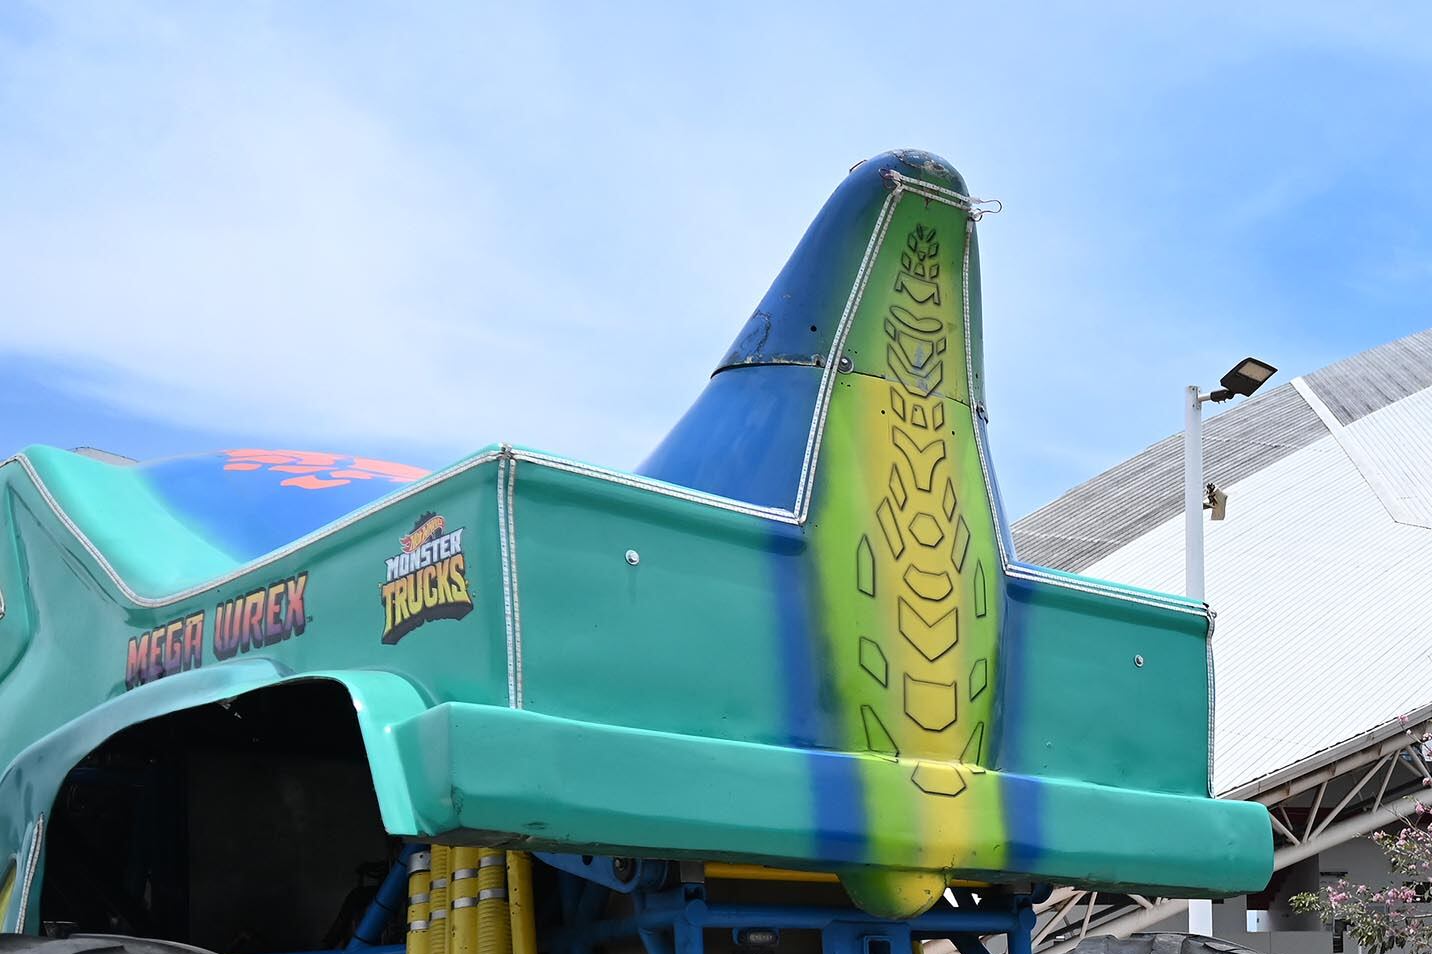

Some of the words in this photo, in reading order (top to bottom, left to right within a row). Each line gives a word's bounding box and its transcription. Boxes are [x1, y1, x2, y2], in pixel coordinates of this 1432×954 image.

[382, 553, 472, 638] TRUCKS
[384, 528, 464, 581] MONSTER
[125, 609, 205, 691] MEGA
[213, 571, 308, 661] WREX
